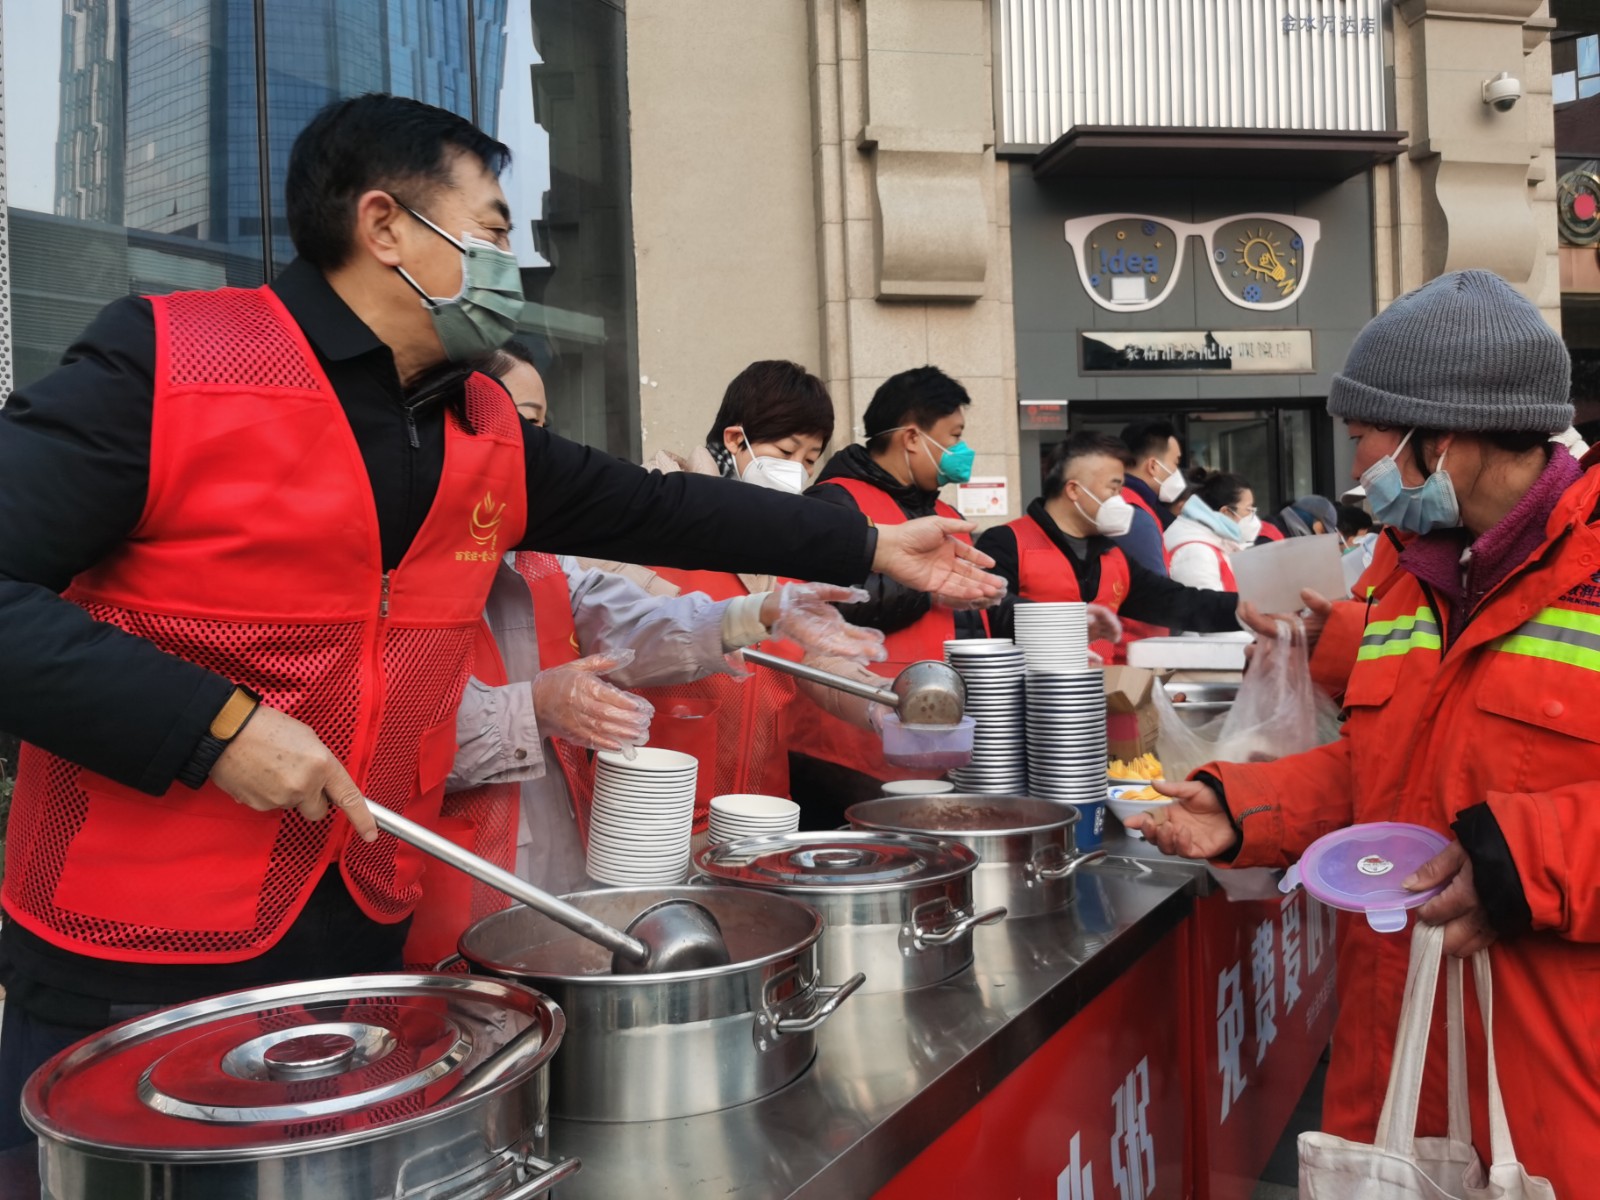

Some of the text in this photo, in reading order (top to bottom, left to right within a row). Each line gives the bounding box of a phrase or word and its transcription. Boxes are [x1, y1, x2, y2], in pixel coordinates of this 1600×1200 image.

[1281, 13, 1375, 36] 金水万达店
